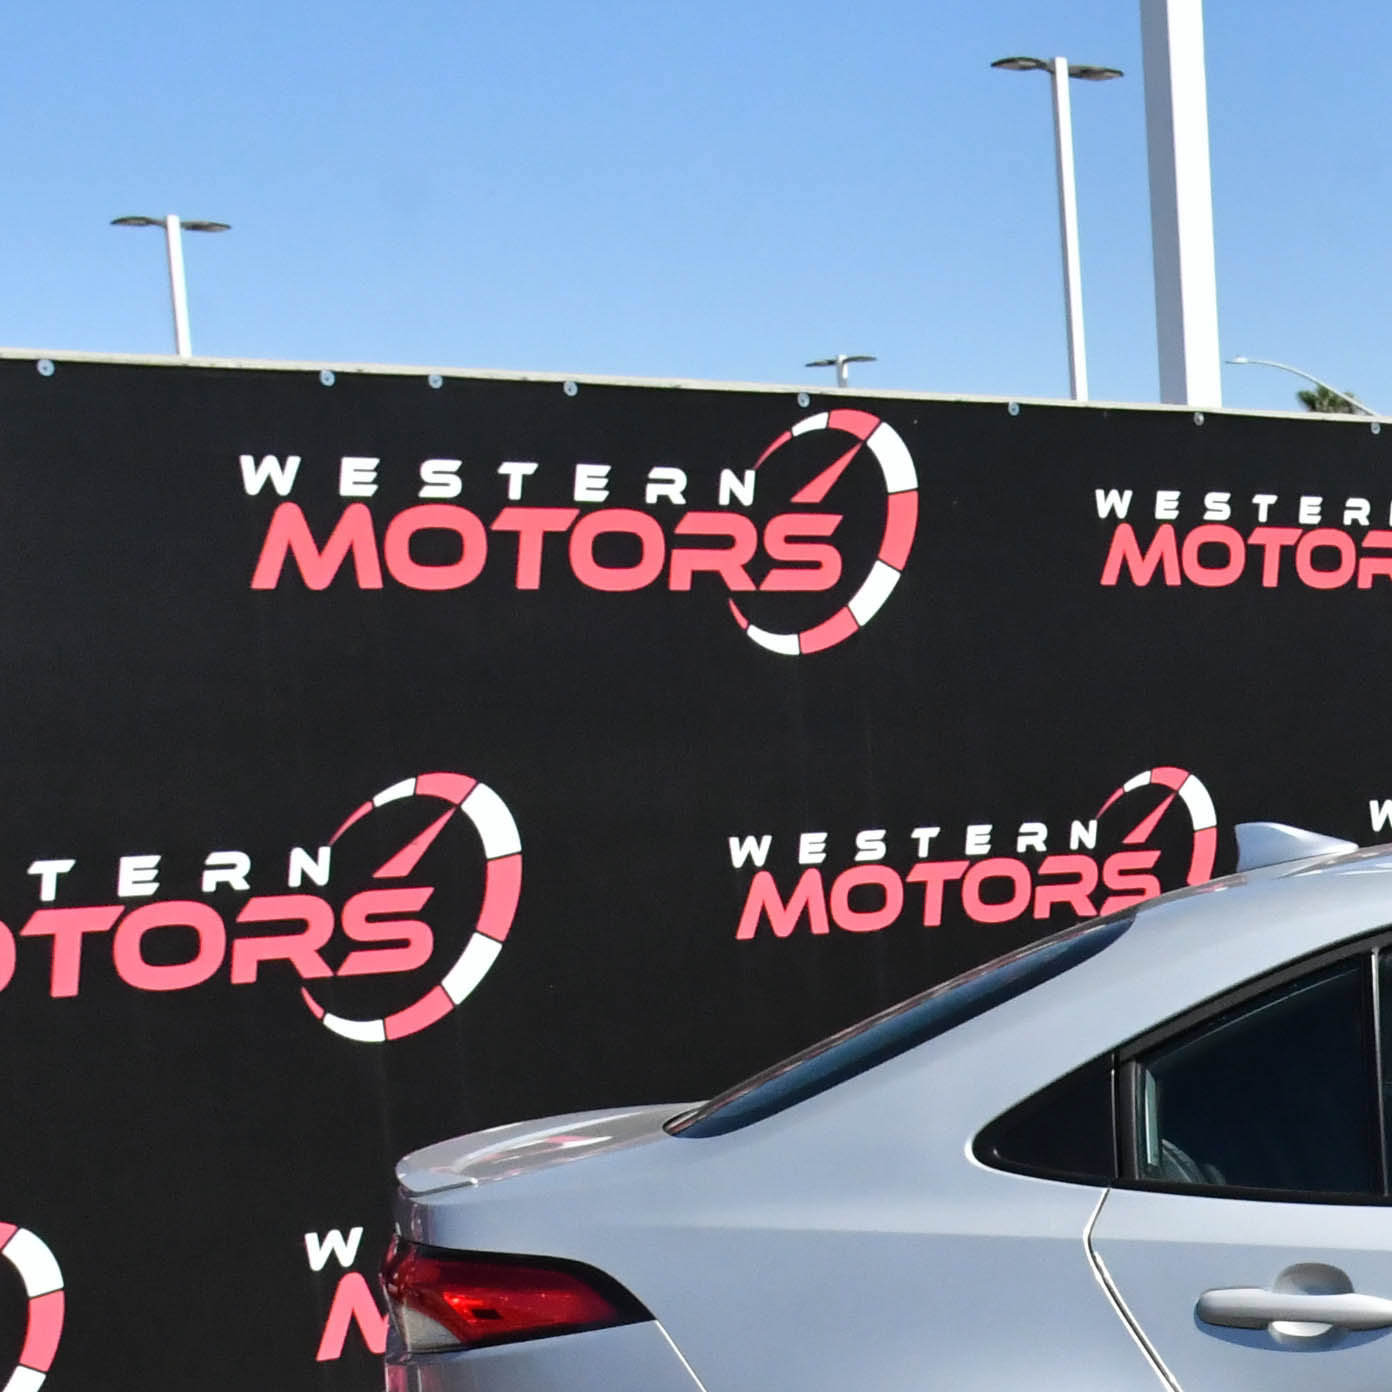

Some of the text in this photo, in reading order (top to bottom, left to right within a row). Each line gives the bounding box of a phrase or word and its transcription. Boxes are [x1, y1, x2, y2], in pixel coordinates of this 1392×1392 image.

[239, 454, 757, 505] WESTERN
[251, 502, 843, 591] MOTORS
[27, 846, 332, 902] TERN
[729, 820, 1098, 868] WESTERN
[736, 850, 1161, 940] MOTORS
[0, 887, 436, 998] TORS
